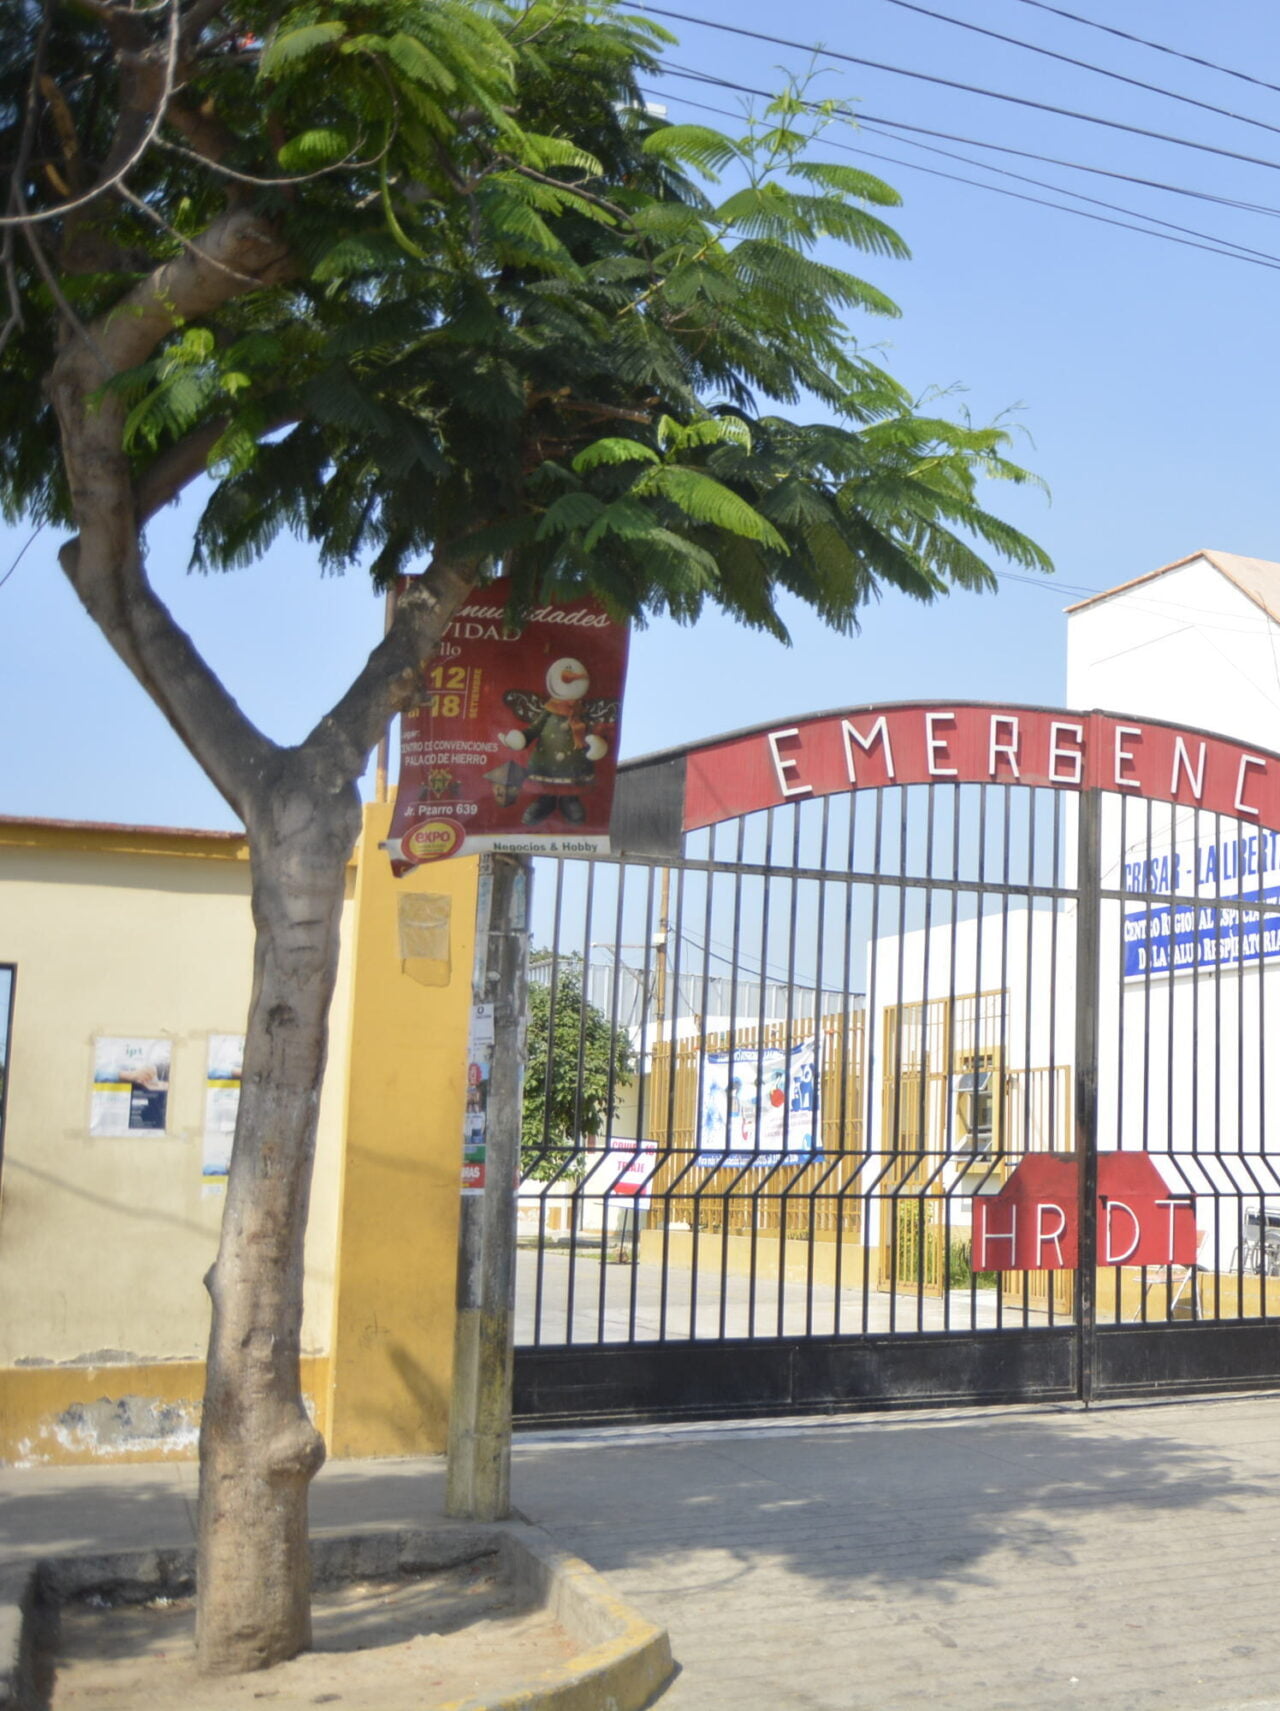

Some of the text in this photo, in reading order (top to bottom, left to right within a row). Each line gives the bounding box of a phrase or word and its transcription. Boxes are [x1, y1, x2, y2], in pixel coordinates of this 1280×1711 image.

[431, 666, 466, 689] 12
[431, 695, 460, 717] 18
[434, 740, 499, 752] CONVENCIONES
[437, 752, 450, 764] DE
[451, 753, 488, 765] HIERRO
[418, 805, 454, 816] Pzarro
[455, 803, 478, 815] 639
[493, 842, 547, 852] Negocios
[562, 842, 599, 853] Hobby
[1124, 917, 1160, 942] CENTO
[1161, 908, 1214, 936] RGIOAL
[1168, 942, 1202, 965] ALU
[982, 1199, 1191, 1268] HRDT
